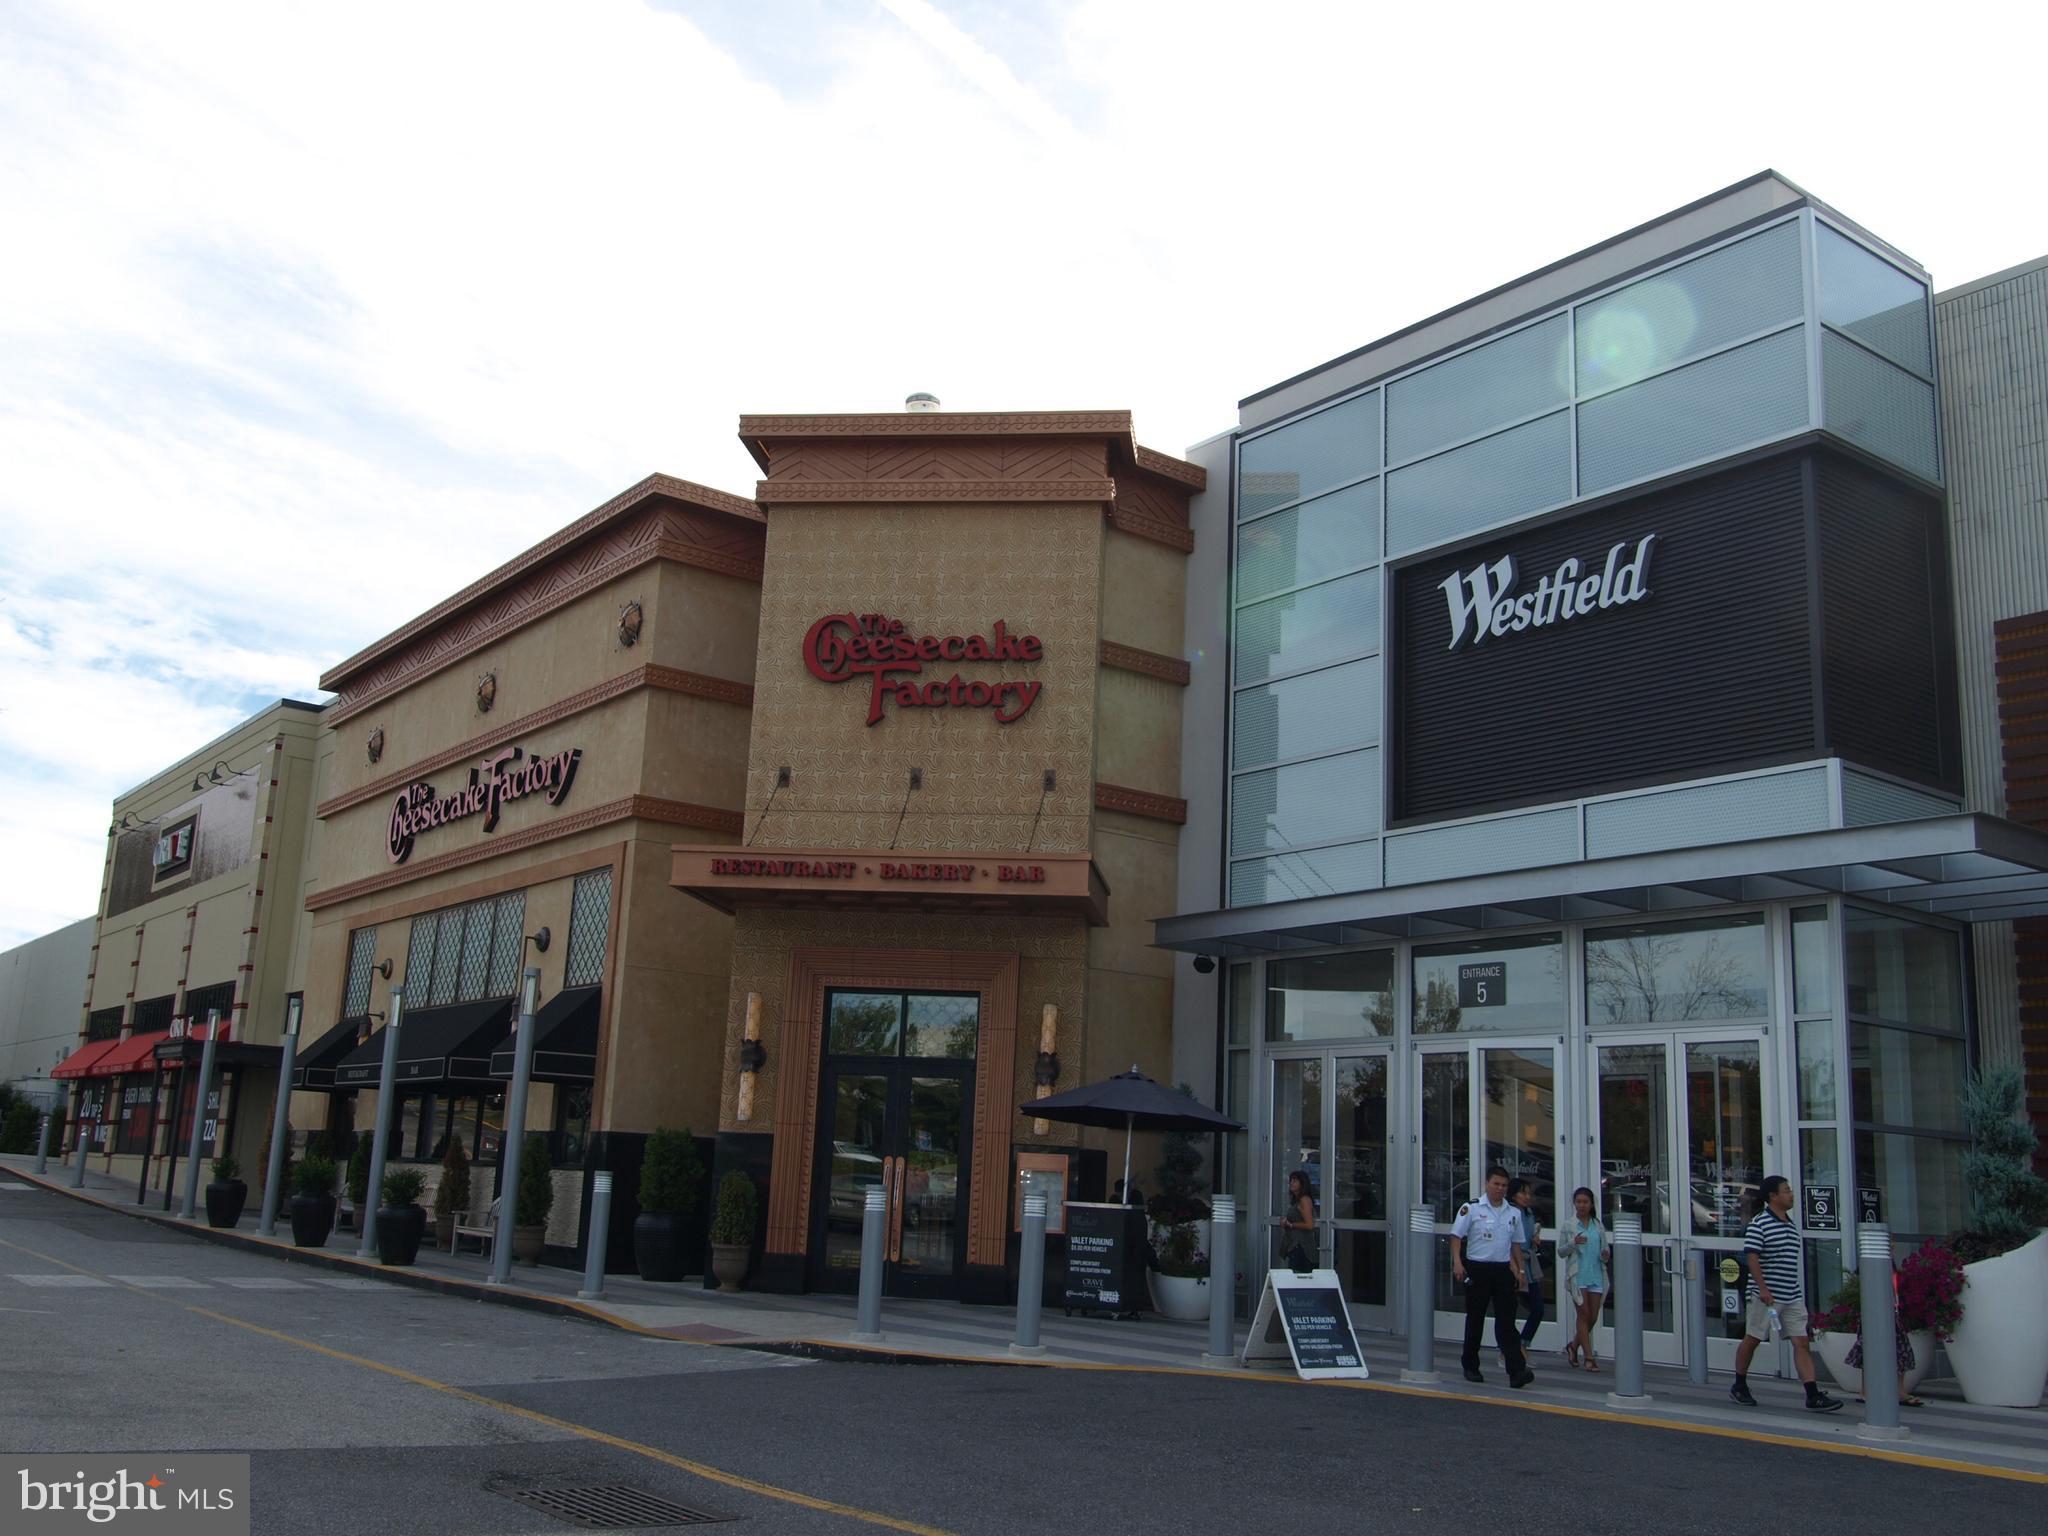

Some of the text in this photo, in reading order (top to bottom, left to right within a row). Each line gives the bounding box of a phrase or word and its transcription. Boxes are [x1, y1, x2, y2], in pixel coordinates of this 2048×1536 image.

[1437, 534, 1657, 650] Westfield
[860, 613, 905, 635] The
[802, 612, 1043, 683] Cheesecake
[850, 660, 1043, 727] Factory
[411, 783, 432, 805] The
[385, 747, 580, 865] Cheesecake Factory
[711, 859, 1046, 883] RESTAURANT BAKERY BAR
[1462, 966, 1501, 979] ENTRANCE
[1476, 981, 1488, 1003] 5
[81, 1088, 94, 1119] 20
[1071, 1236, 1114, 1247] VALET PARKING
[1291, 1316, 1337, 1324] VALET PARKING
